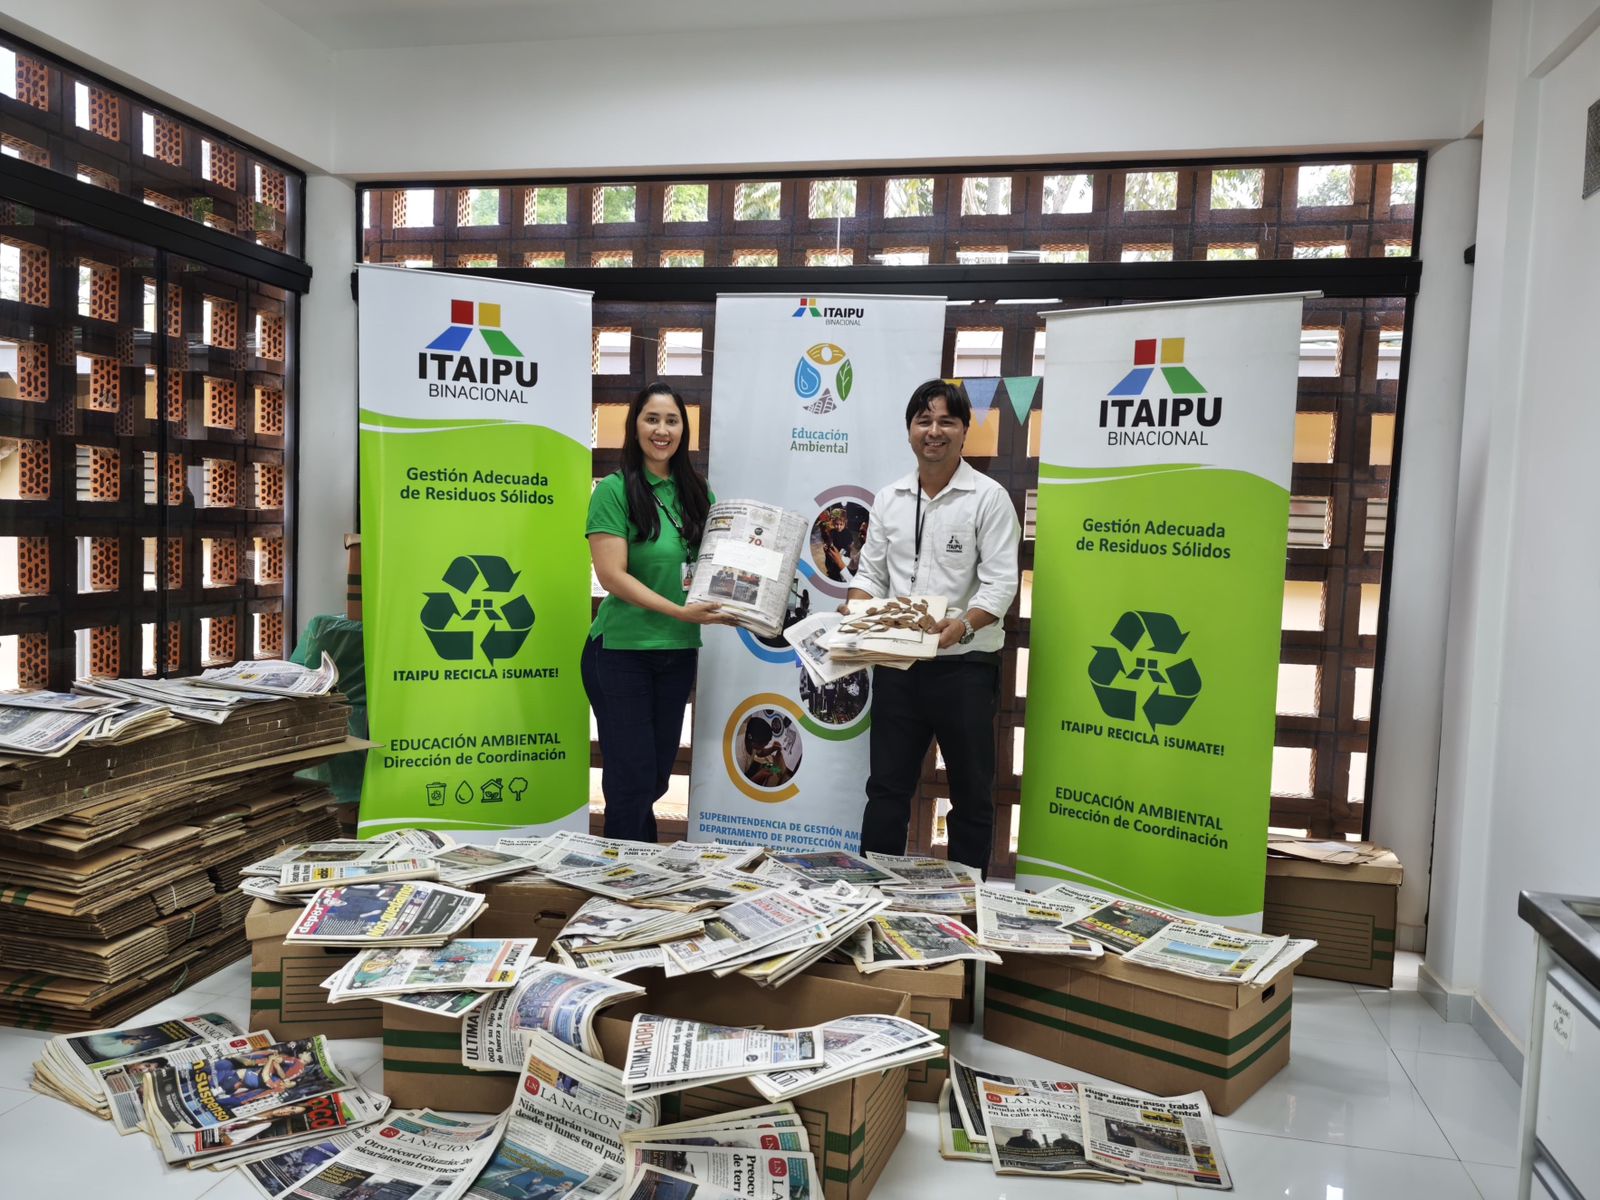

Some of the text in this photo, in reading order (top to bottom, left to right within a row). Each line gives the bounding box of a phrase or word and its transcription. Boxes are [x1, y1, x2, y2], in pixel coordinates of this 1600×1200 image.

[823, 307, 864, 319] ITAIPU
[418, 352, 538, 387] ITAIPU
[429, 384, 528, 404] BINACIONAL
[1099, 397, 1222, 428] ITAIPU
[792, 428, 848, 441] Educación
[1108, 431, 1208, 446] BINACIONAL
[790, 441, 848, 454] Ambiental
[406, 467, 548, 486] Gestión Adecuada
[400, 486, 554, 505] de Residuos Sólidos
[1083, 518, 1225, 538] Gestión Adecuada
[1076, 537, 1231, 559] de Residuos Sólidos
[393, 670, 439, 681] ITAIPU
[444, 669, 498, 680] RECICLA
[391, 732, 560, 751] EDUCACIÓN AMBIENTAL
[1061, 720, 1103, 736] ITAIPU
[1108, 727, 1159, 745] RECICLA
[384, 749, 566, 769] Dirección de Coordinación
[1056, 787, 1223, 831] EDUCACIÓN AMBIENTAL
[700, 812, 787, 830] SUPERINTENDENCIA
[790, 823, 801, 832] DE
[804, 824, 842, 837] GESTIÓN
[1049, 802, 1228, 849] Dirección de Coordinación
[700, 824, 768, 840] DEPARTAMENTO
[771, 833, 782, 842] DE
[785, 835, 839, 848] PROTECCIÓN
[488, 1013, 496, 1027] hijo
[496, 1012, 502, 1020] se
[466, 1015, 479, 1061] ULTIMA
[488, 1029, 493, 1038] su
[487, 1047, 496, 1062] OGD
[496, 1054, 504, 1064] de
[628, 1023, 657, 1080] ULTIMA HORA
[194, 1072, 230, 1121] suspenso
[527, 1080, 538, 1091] LN
[540, 1087, 557, 1105] LA
[1084, 1088, 1200, 1110] Hugo Javier puso trabas
[518, 1096, 544, 1117] Niños
[546, 1110, 581, 1131] podrán
[987, 1105, 1015, 1113] Deuda
[1031, 1108, 1071, 1118] Gobierno
[1167, 1109, 1201, 1118] Central
[397, 1134, 415, 1144] LA
[515, 1108, 625, 1165] desde el lunes en el país
[355, 1145, 402, 1163] sicariatos
[415, 1162, 435, 1172] tres
[364, 1138, 388, 1151] Otro
[388, 1145, 422, 1160] récord
[733, 1154, 742, 1168] de
[773, 1160, 782, 1174] LN
